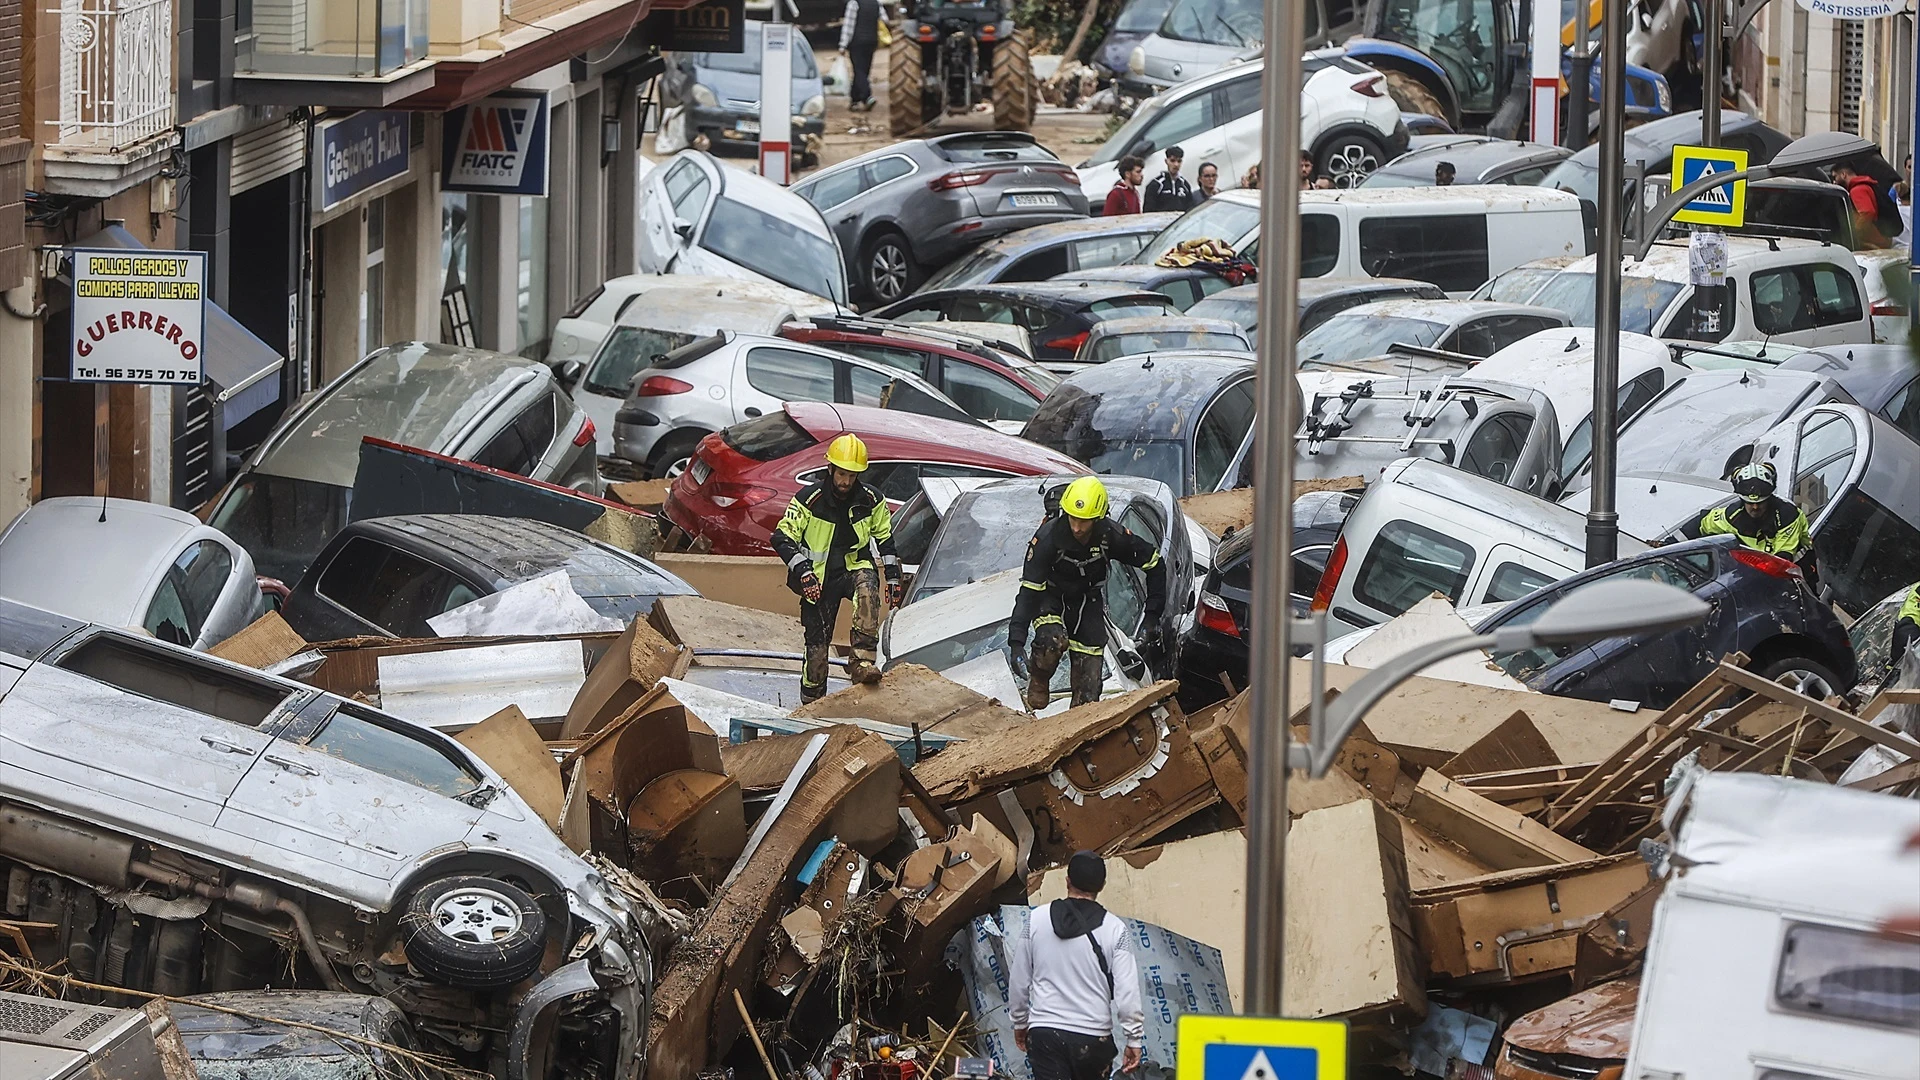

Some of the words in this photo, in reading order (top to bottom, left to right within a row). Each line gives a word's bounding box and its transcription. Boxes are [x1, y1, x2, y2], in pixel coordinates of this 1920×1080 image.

[1812, 0, 1891, 16] PASTISSERIA
[461, 153, 516, 170] FIATC
[459, 169, 512, 177] SEGUROS
[89, 257, 131, 275] POLLOS
[133, 258, 177, 277] ASADOS
[178, 259, 188, 277] Y
[77, 280, 125, 298] COMIDAS
[127, 281, 156, 299] PARA
[158, 282, 199, 300] LLEVAR
[77, 311, 198, 360] GUERRERO
[78, 368, 101, 377] Tel.
[105, 368, 123, 378] 96
[127, 369, 153, 379] 375
[158, 370, 175, 379] 70
[179, 371, 197, 380] 76
